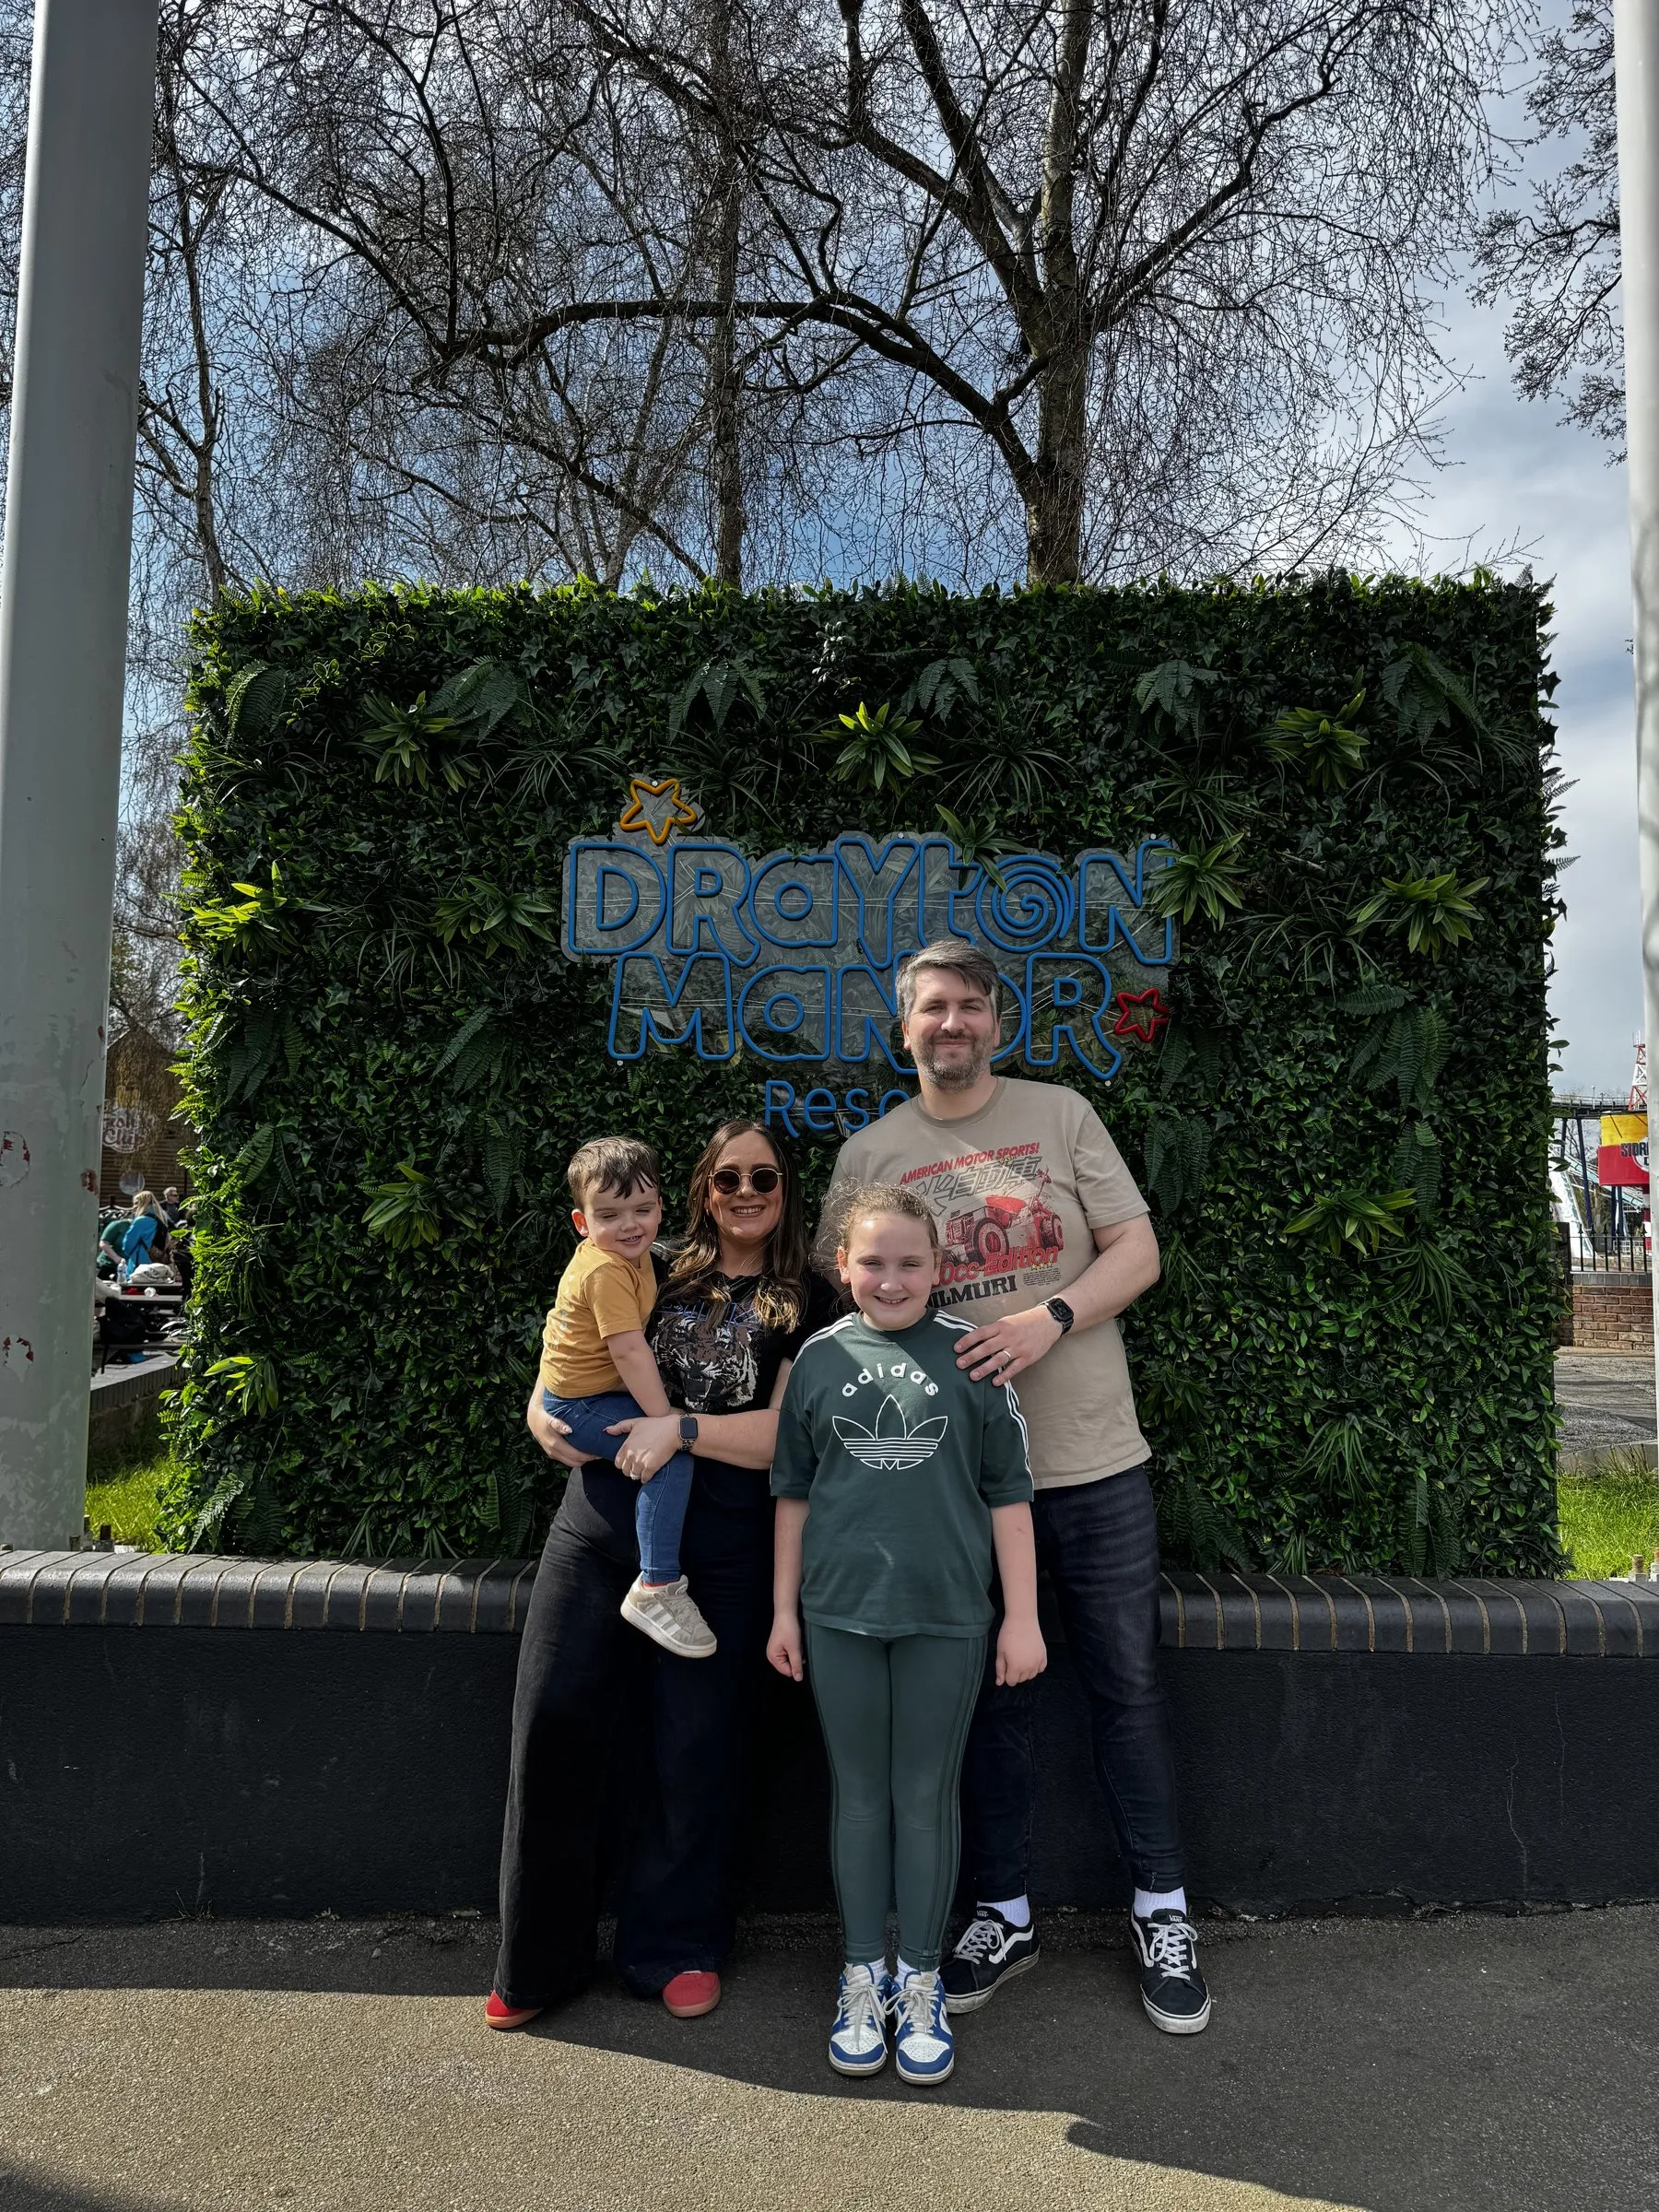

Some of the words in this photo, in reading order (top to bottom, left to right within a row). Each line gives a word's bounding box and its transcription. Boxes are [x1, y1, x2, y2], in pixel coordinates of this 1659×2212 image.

[900, 1159, 953, 1184] AMERICAN
[954, 1149, 995, 1170] MOTOR
[995, 1142, 1040, 1159] SPORTS!
[931, 1261, 980, 1288] 0cc
[983, 1246, 1059, 1277] Edition
[926, 1275, 1018, 1308] ILMURI
[841, 1362, 939, 1397] adidas
